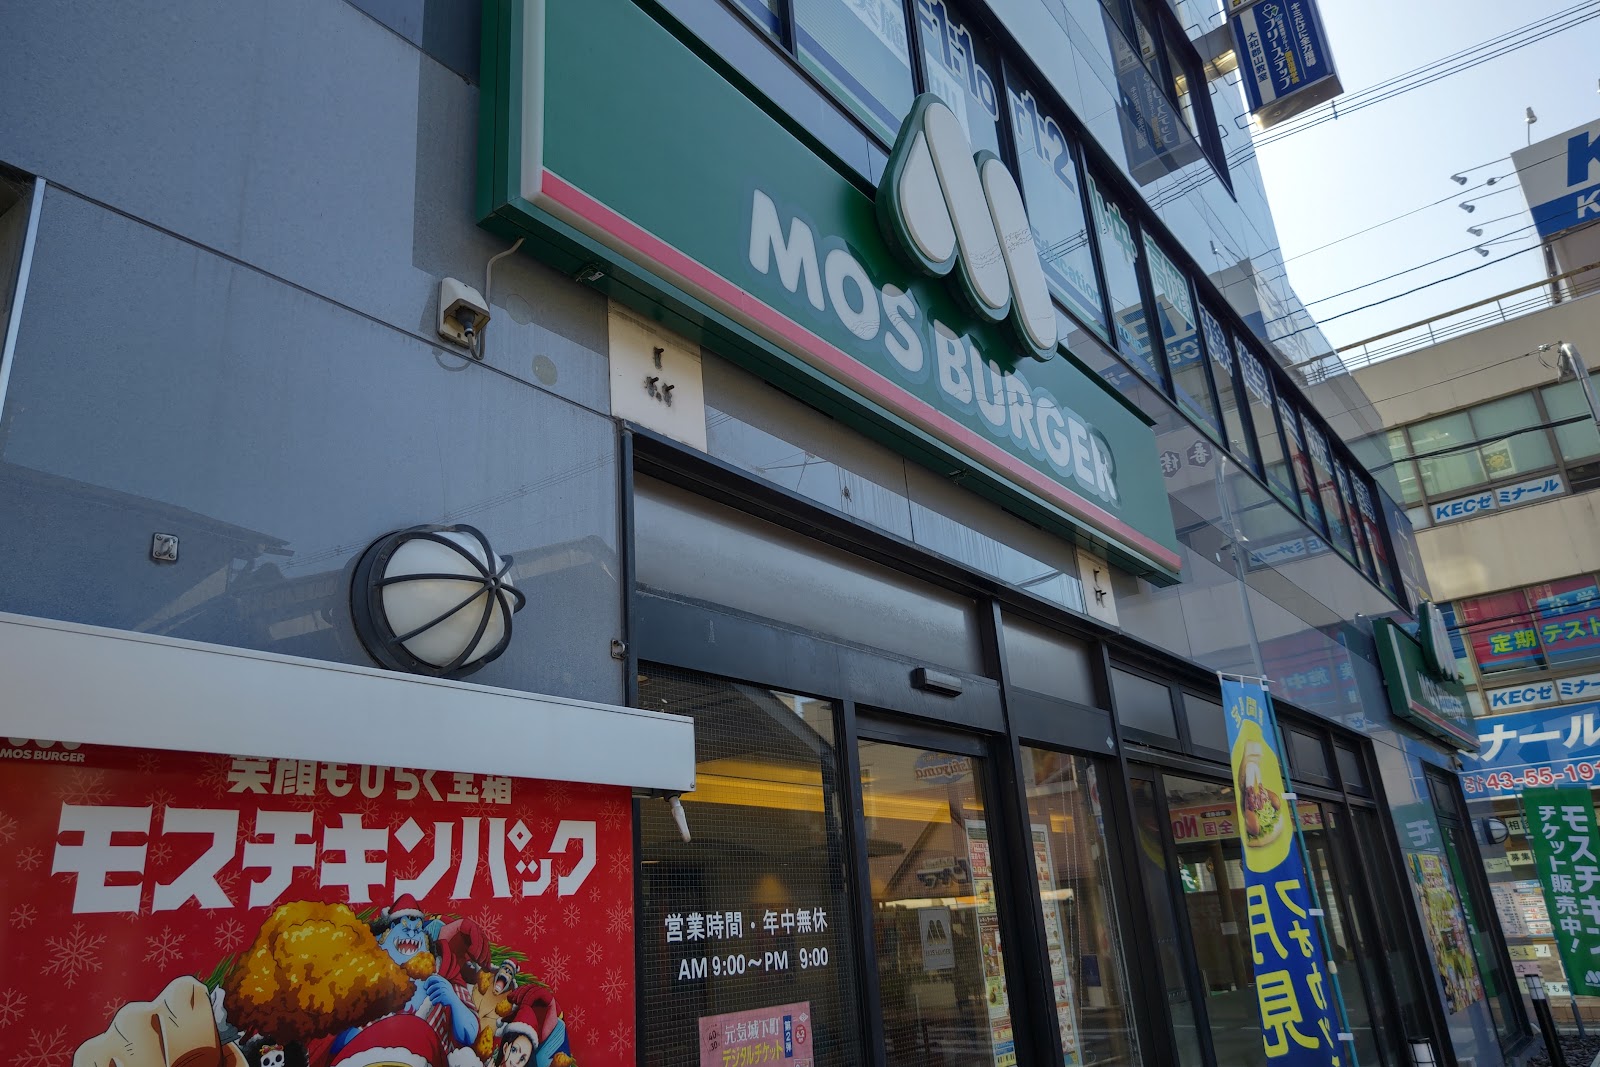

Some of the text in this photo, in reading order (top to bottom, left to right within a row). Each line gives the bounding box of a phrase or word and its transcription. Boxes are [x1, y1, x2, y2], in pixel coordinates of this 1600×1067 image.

[1246, 31, 1269, 84] 大和郡山教室
[1263, 17, 1292, 91] フリーステップ
[748, 188, 925, 374] MOS
[933, 317, 1117, 500] BURGER
[1457, 711, 1600, 762] ナール
[0, 748, 86, 763] MOS BURGER
[1486, 762, 1600, 790] 43-55-19
[51, 802, 598, 914] モスチキンパック
[664, 907, 829, 943] 営業時間・年中無休
[678, 956, 708, 981] AM
[799, 946, 829, 969] 9:00
[724, 1016, 781, 1045] 元気城下町
[722, 1039, 784, 1067] デジタルチケット
